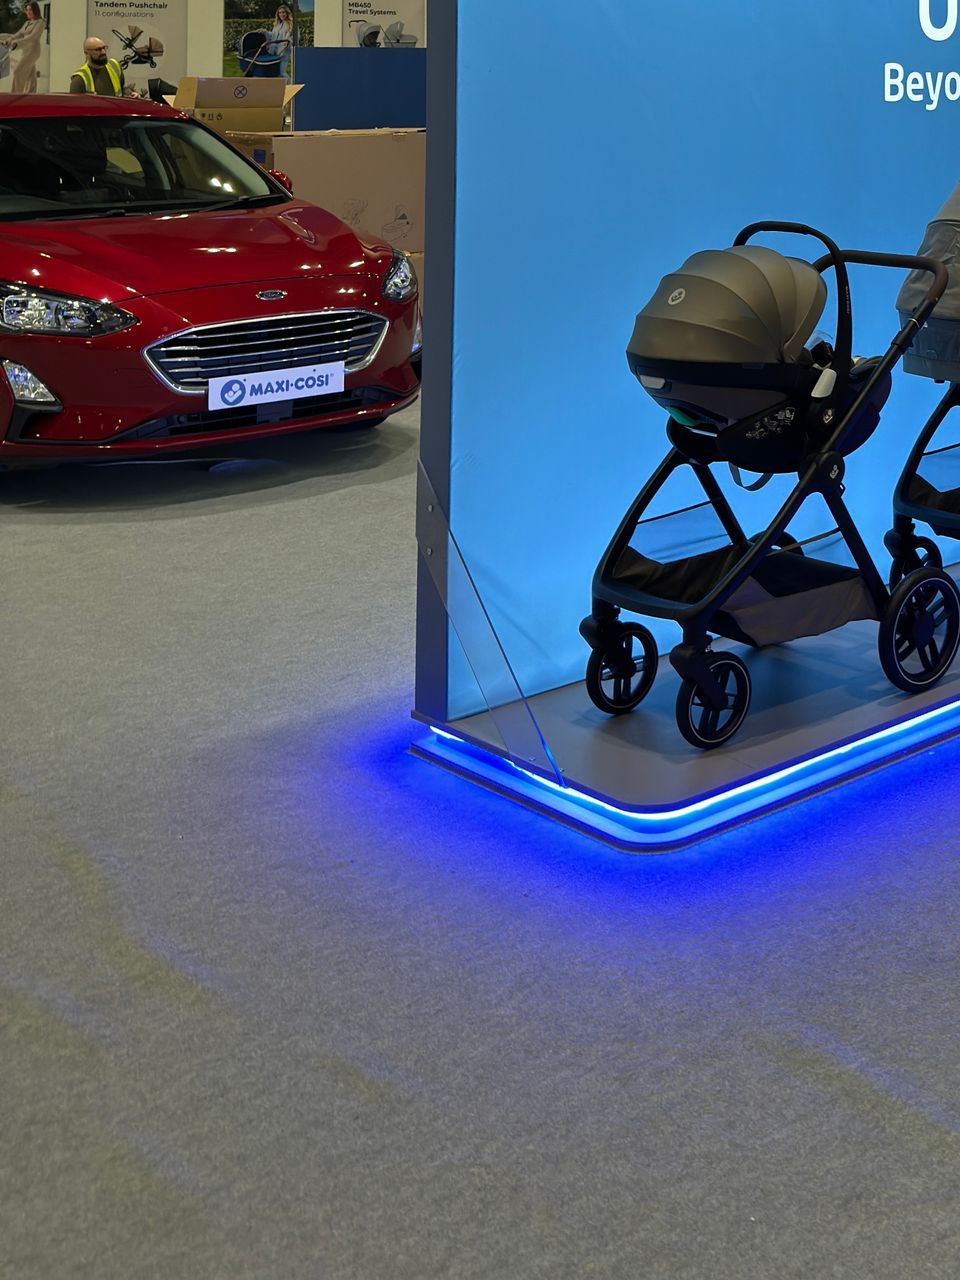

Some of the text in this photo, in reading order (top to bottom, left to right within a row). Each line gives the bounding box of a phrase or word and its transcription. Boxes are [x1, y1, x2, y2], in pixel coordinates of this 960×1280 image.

[94, 0, 168, 9] Tandem Pushchair
[101, 10, 155, 18] configurations
[369, 9, 397, 17] Systems
